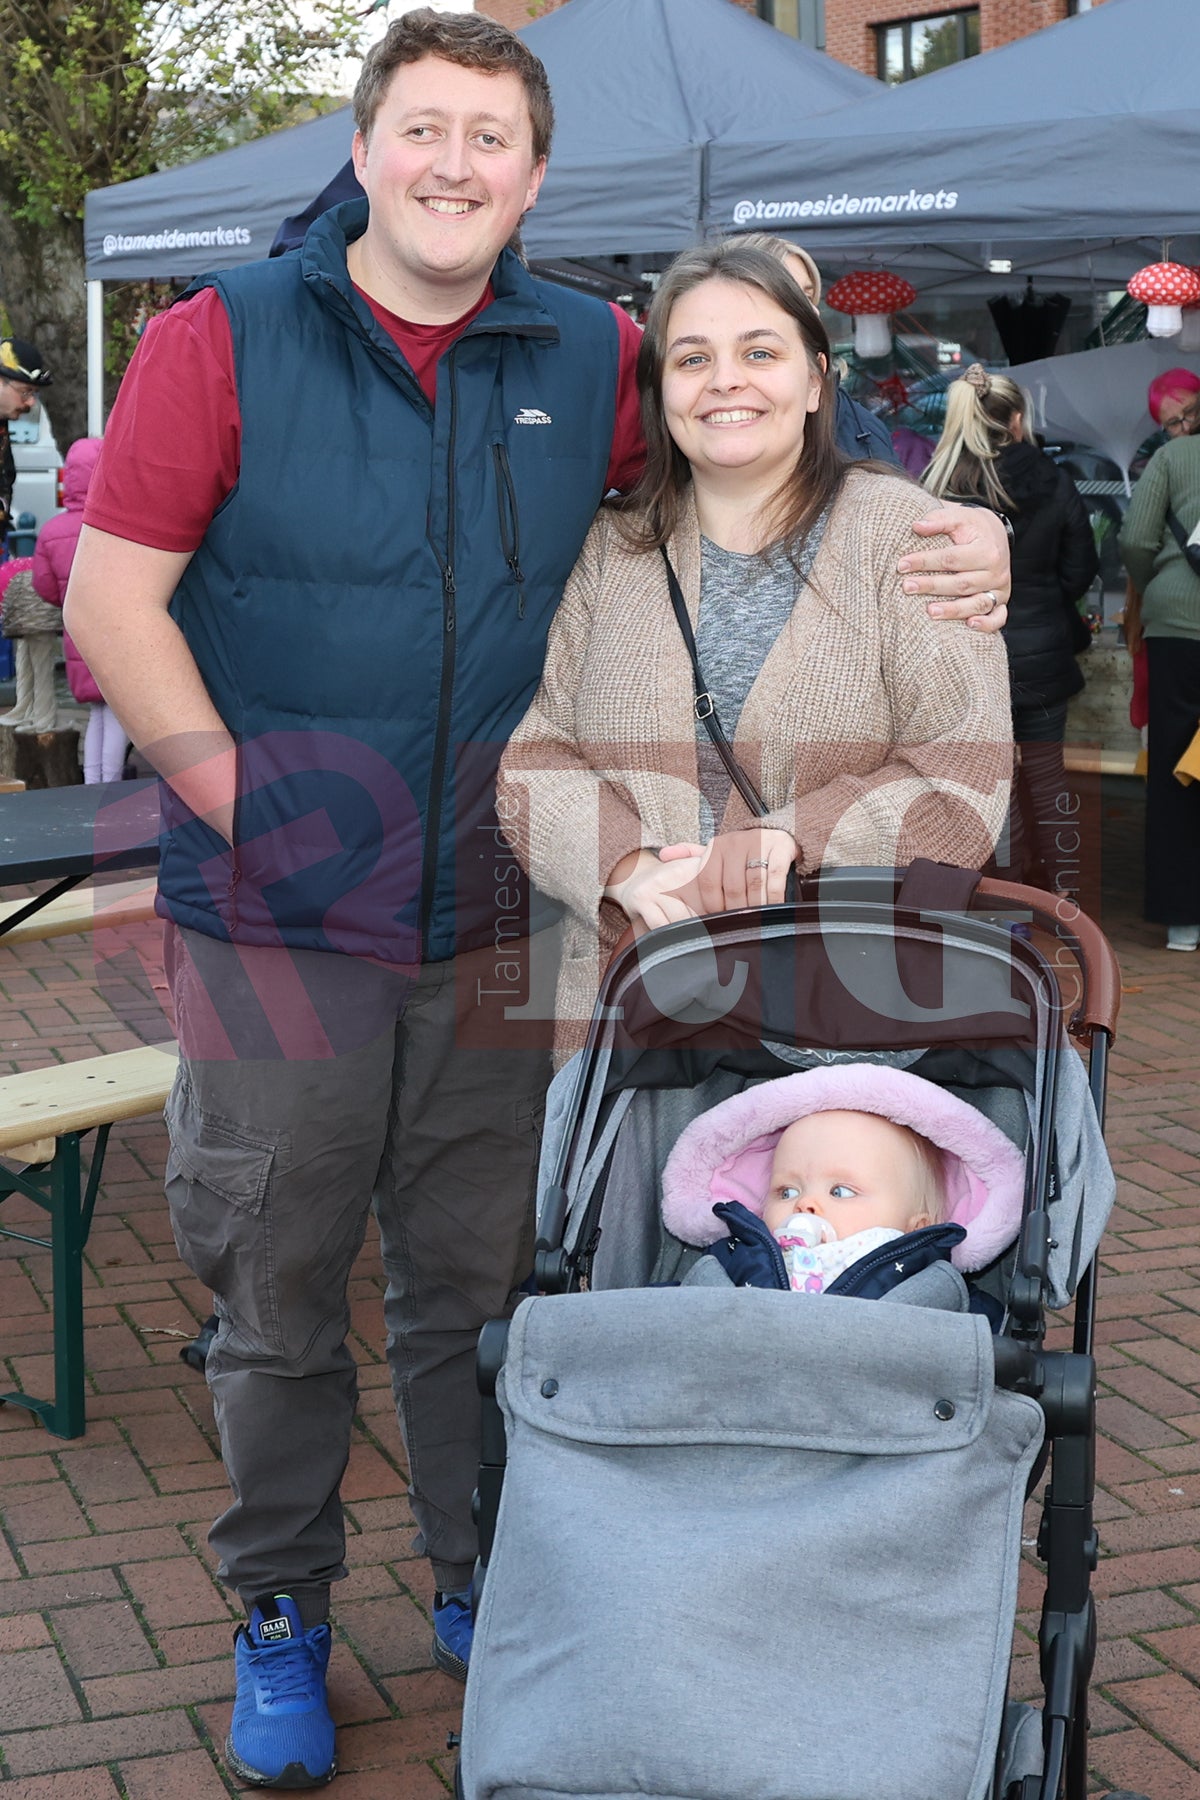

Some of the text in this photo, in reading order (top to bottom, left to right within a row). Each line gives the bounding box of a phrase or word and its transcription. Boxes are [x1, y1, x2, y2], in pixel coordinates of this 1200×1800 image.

[733, 189, 958, 224] @tamesidemarkets
[103, 226, 251, 256] @tamesidemarkets
[514, 416, 552, 425] TRESPASS
[262, 1620, 286, 1634] BAAS
